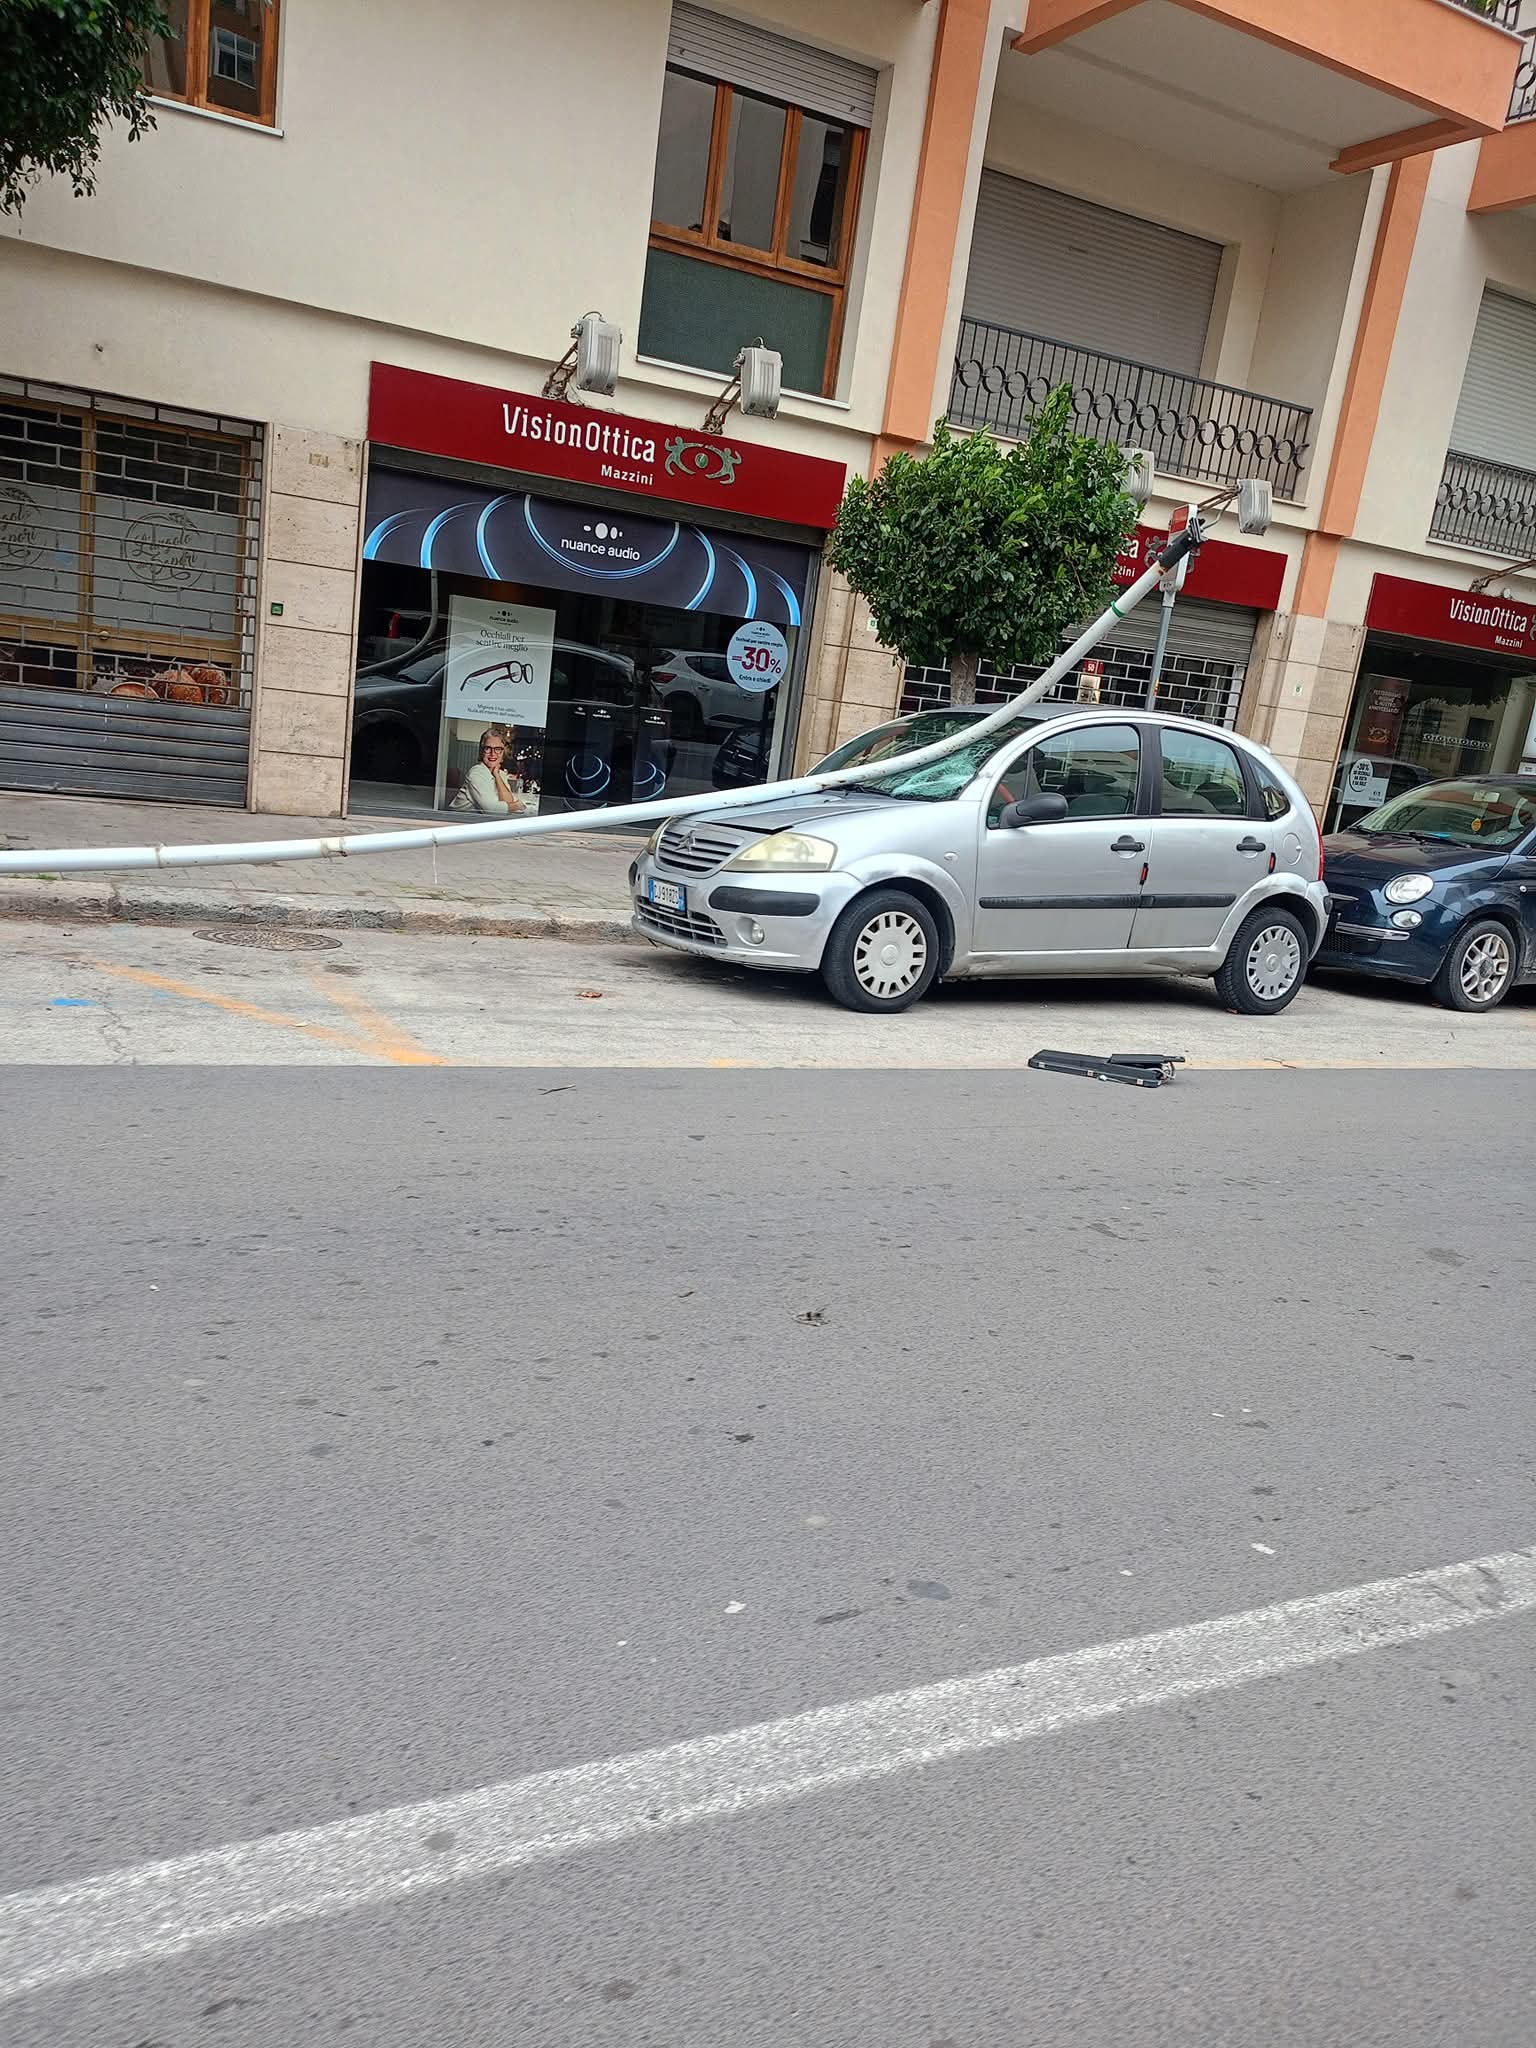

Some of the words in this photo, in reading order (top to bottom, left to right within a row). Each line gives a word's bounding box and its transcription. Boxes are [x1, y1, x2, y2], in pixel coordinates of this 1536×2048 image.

[502, 403, 656, 463] VisionOttica
[601, 464, 653, 486] Mazzini
[561, 539, 606, 555] nuance
[607, 546, 640, 560] audio
[1450, 598, 1527, 632] VisionOttica
[480, 629, 511, 641] Occhiali
[512, 635, 525, 644] per
[1494, 635, 1523, 648] Mazzini
